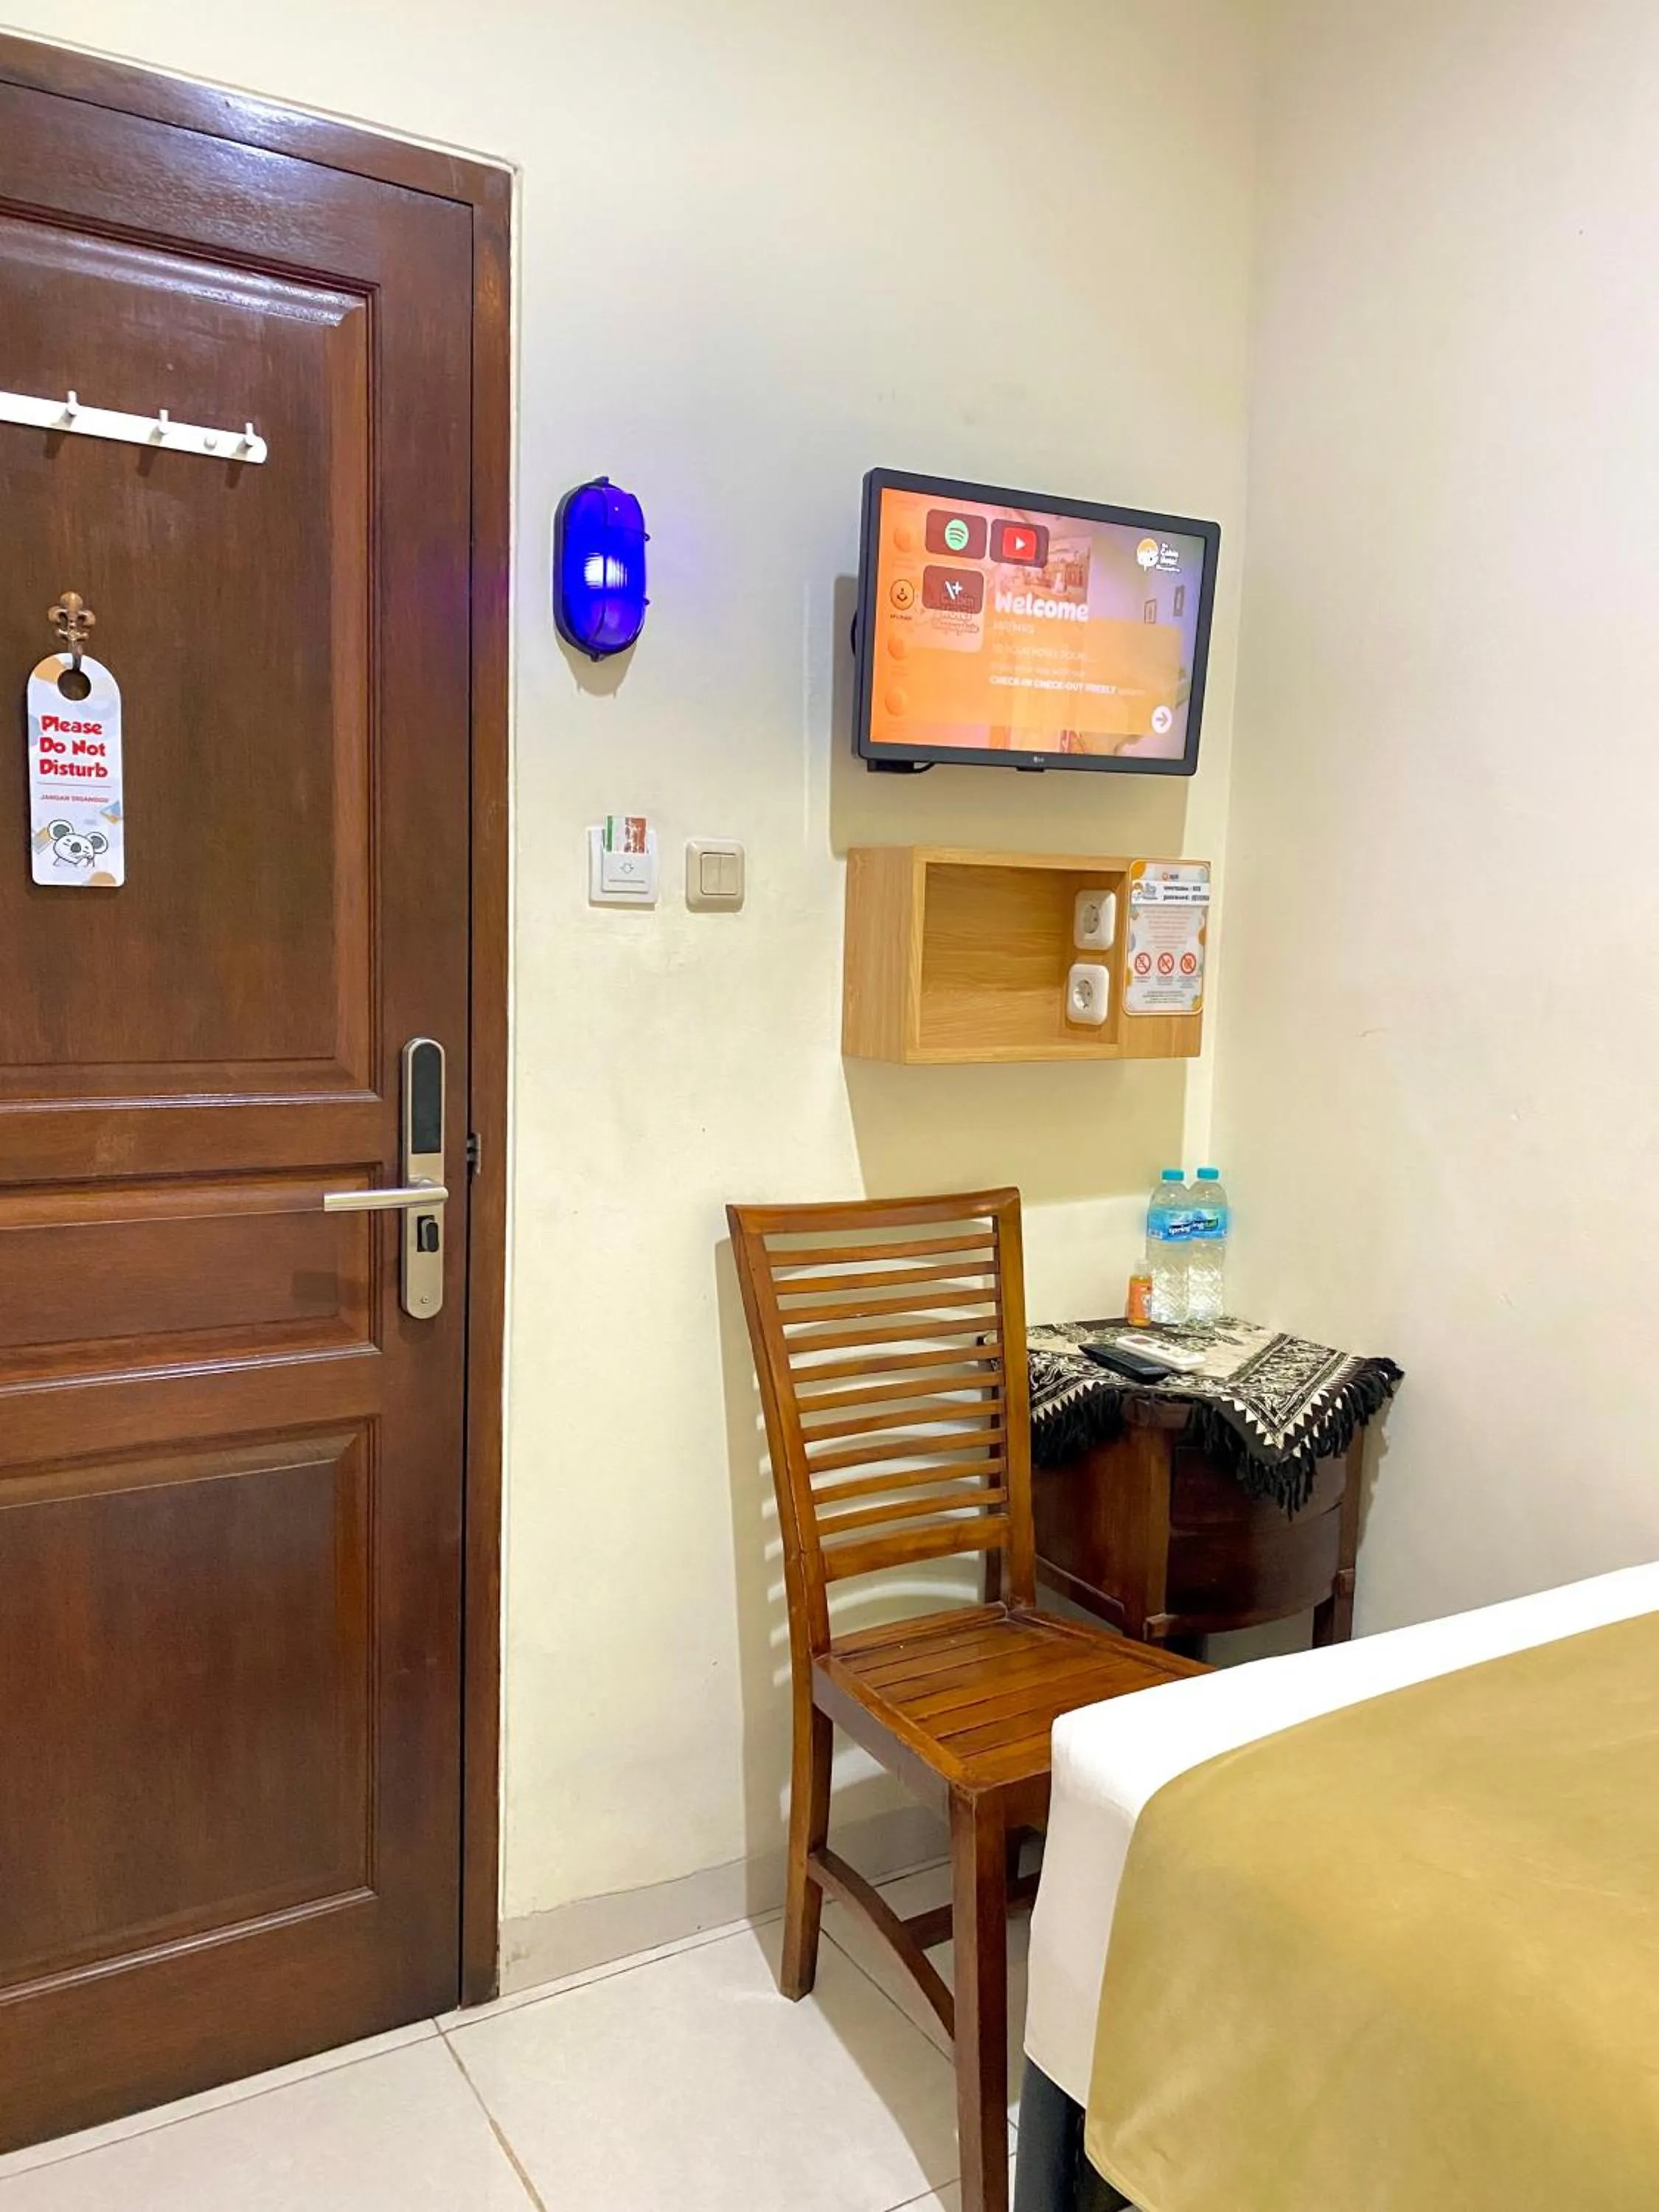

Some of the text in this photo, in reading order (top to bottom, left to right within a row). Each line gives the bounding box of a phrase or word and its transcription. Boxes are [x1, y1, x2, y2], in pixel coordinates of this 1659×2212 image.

[995, 591, 1089, 622] Welcome
[41, 715, 102, 735] Please
[39, 737, 105, 757] Do Not
[39, 759, 108, 778] Disturb
